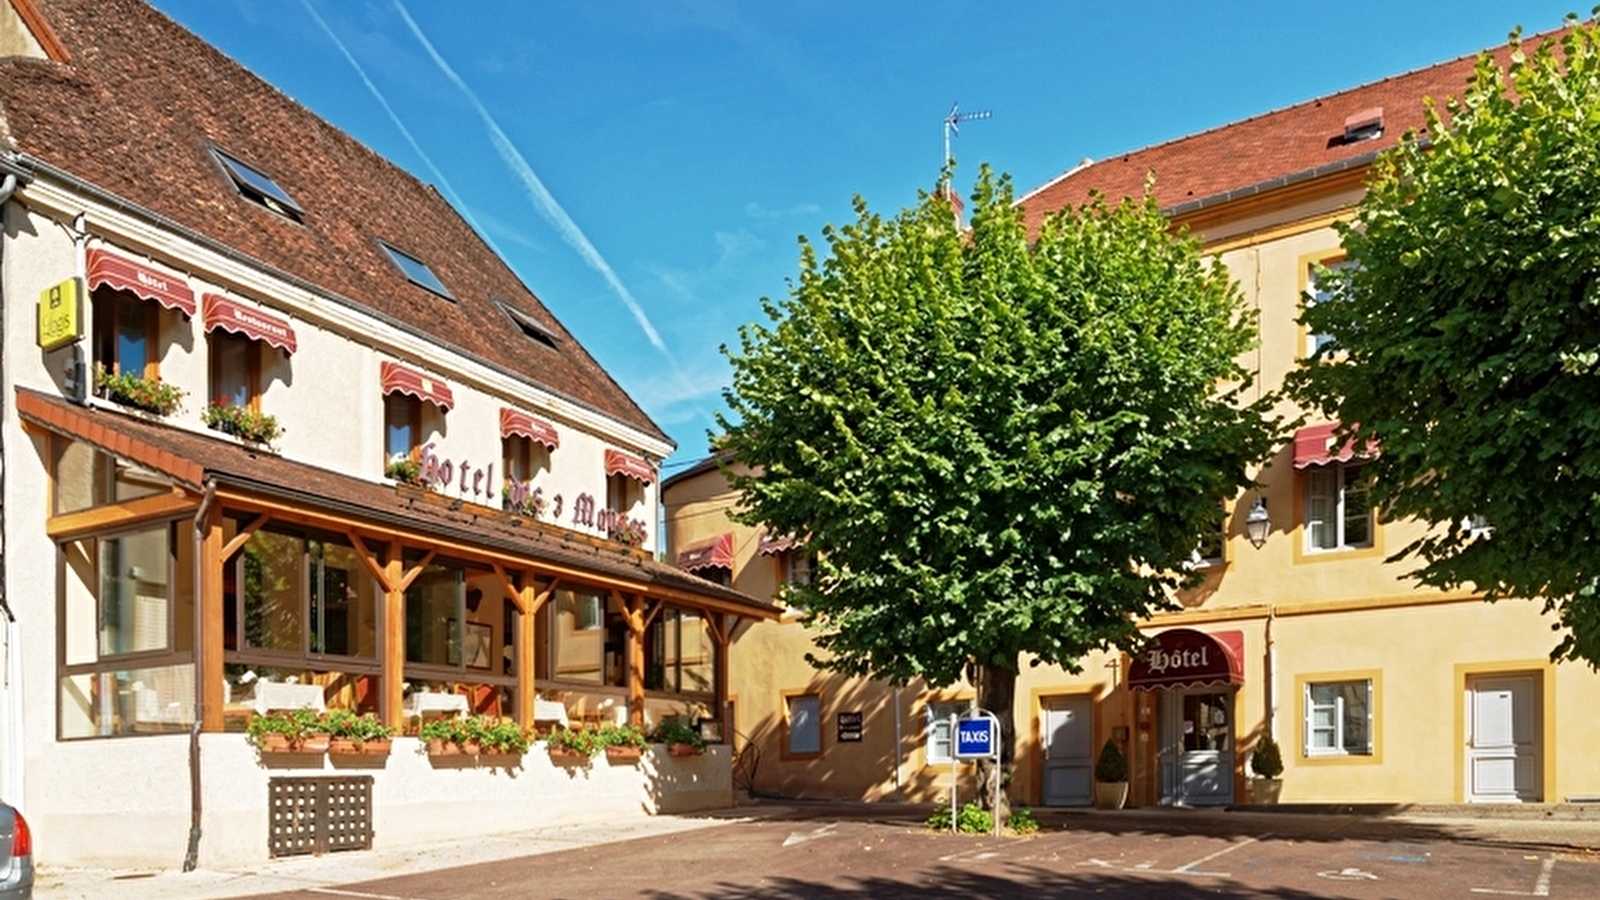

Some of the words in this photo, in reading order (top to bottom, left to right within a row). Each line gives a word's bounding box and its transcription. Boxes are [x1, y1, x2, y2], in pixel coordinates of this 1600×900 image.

[553, 493, 564, 519] 3
[1146, 645, 1209, 674] Hôtel
[960, 730, 989, 743] TAXIS
